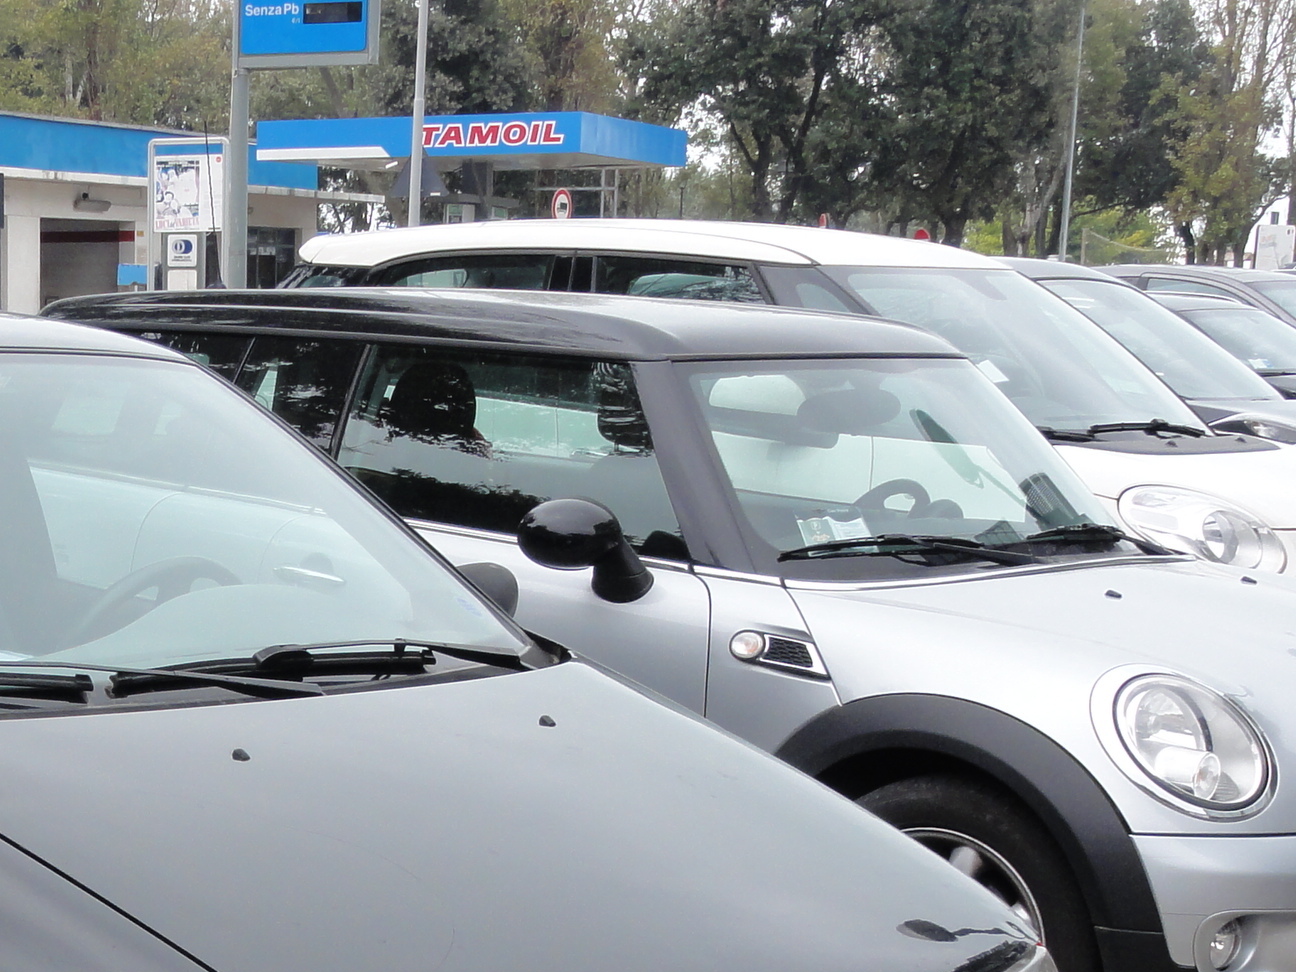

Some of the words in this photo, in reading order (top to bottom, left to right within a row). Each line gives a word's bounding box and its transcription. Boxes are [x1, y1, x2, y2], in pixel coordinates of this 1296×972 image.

[245, 4, 282, 16] Senza
[284, 3, 299, 15] Pb
[422, 121, 564, 147] TAMOIL
